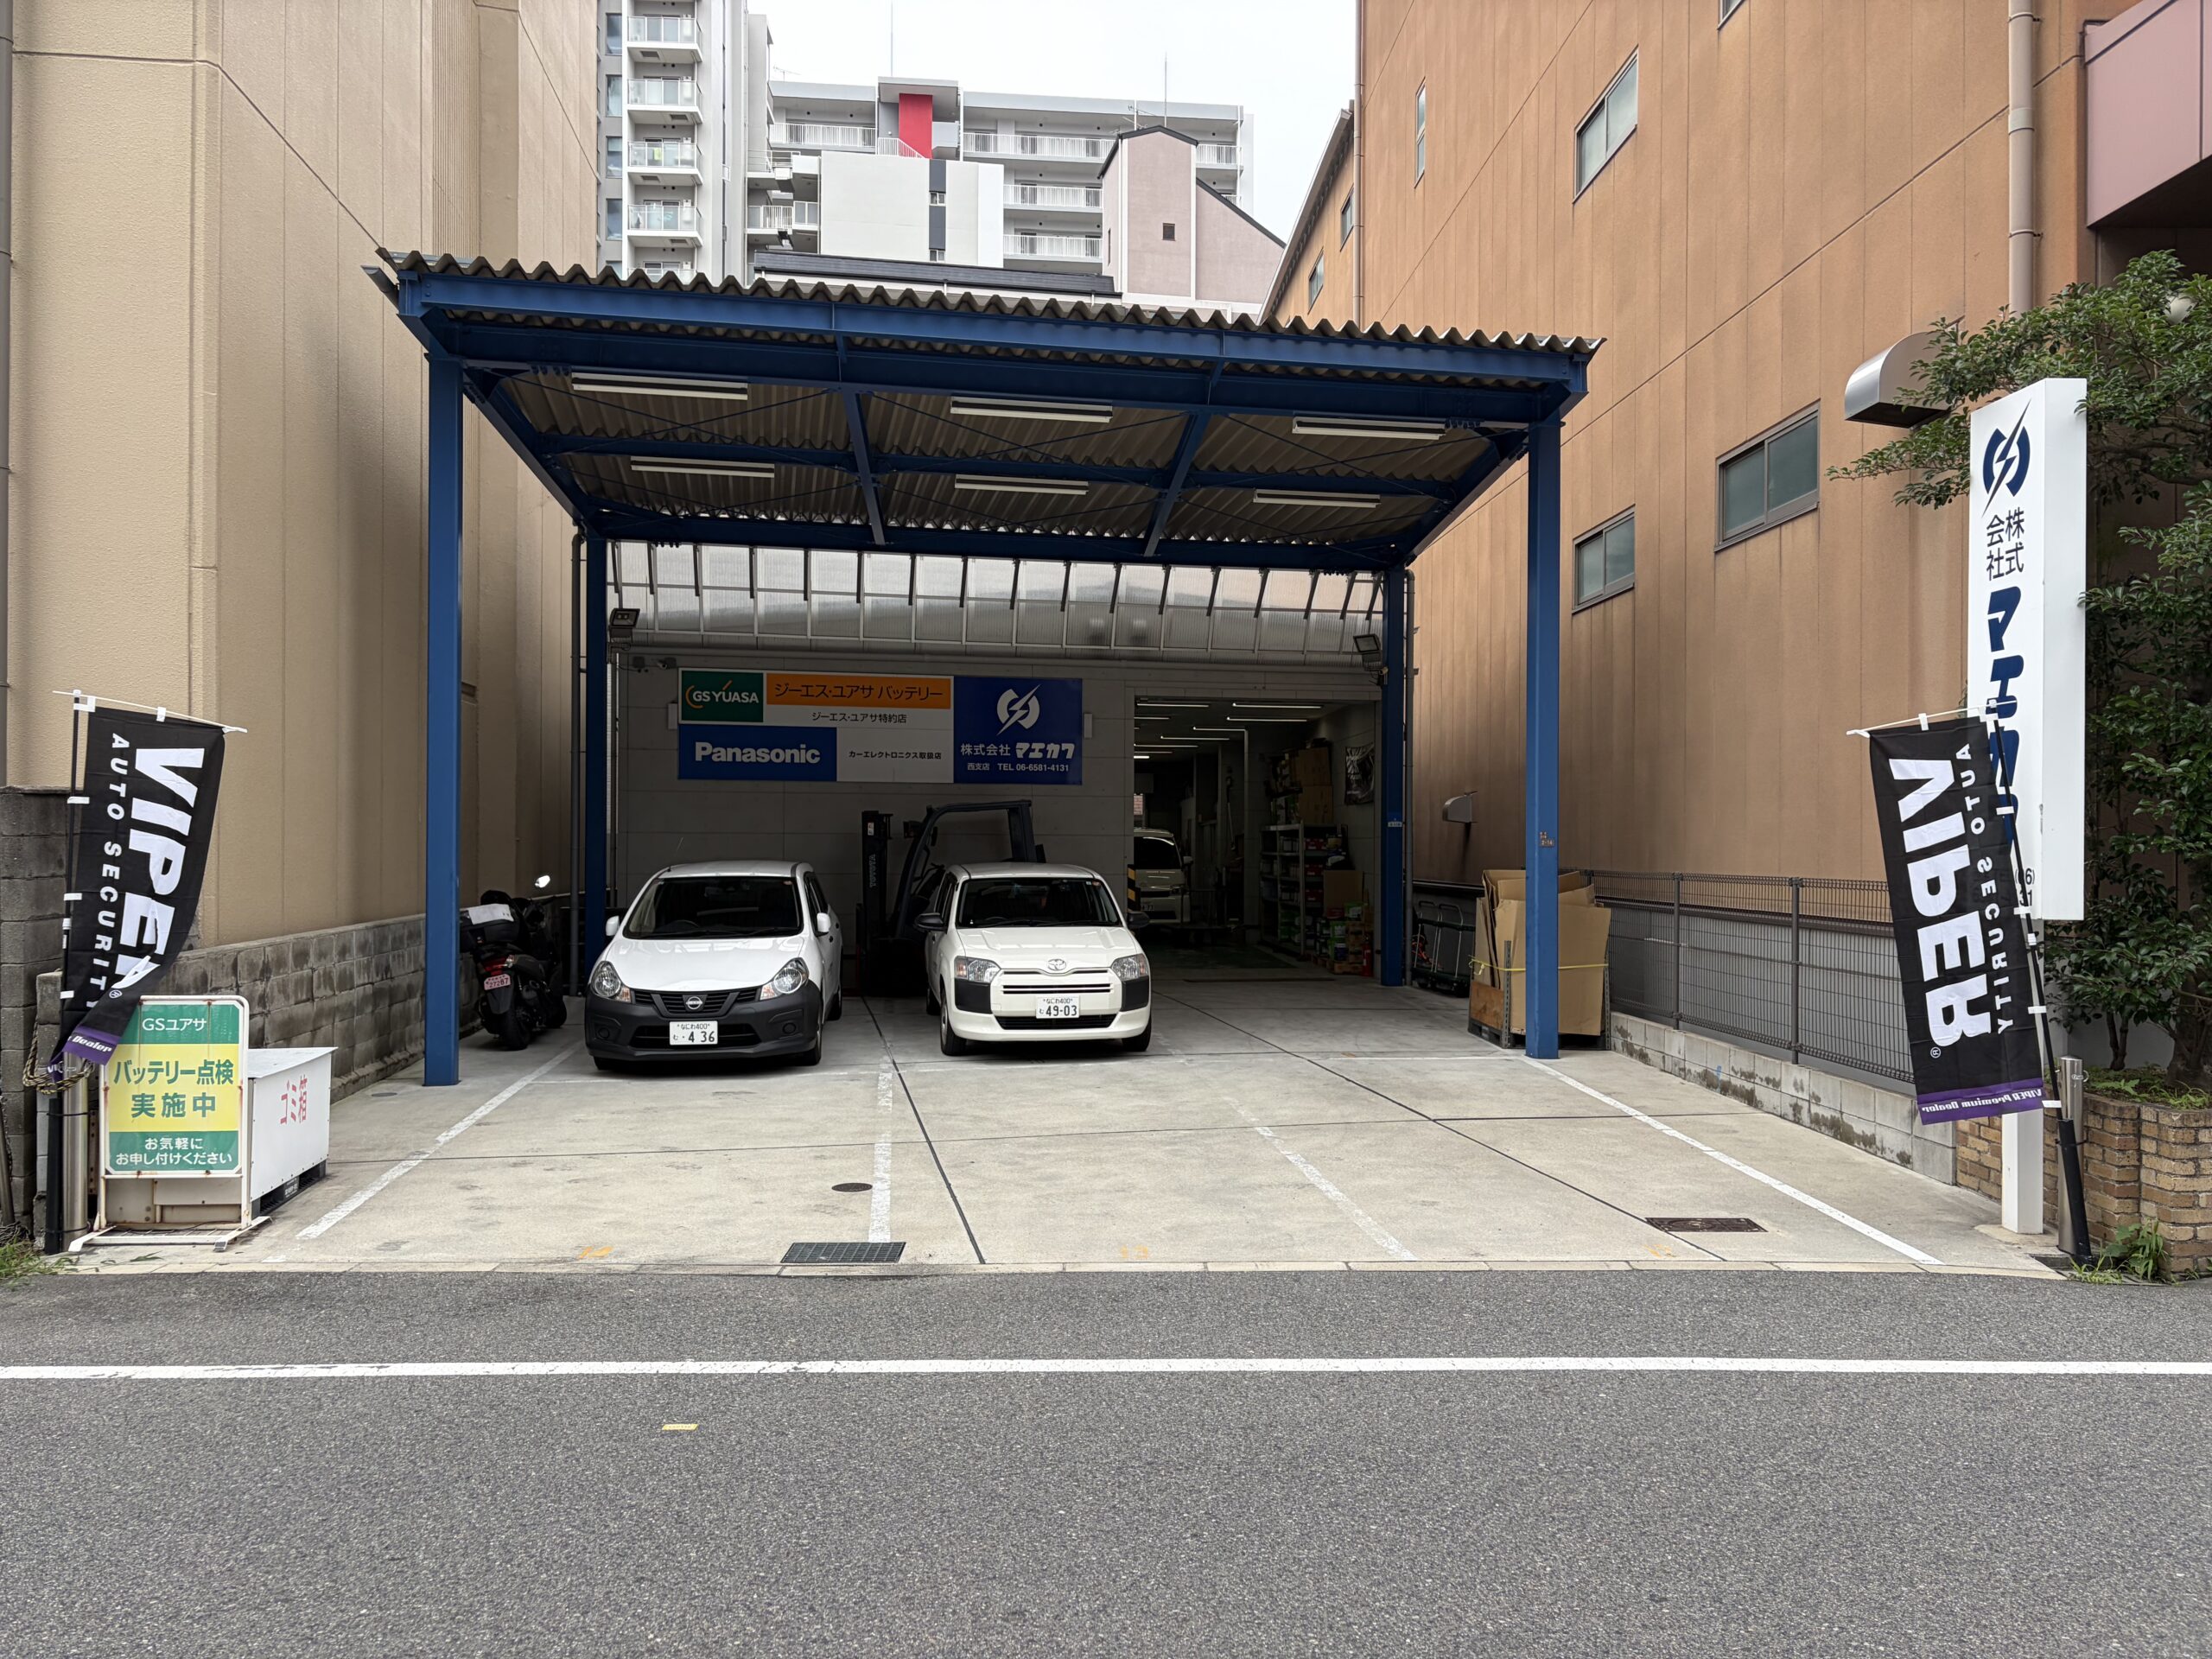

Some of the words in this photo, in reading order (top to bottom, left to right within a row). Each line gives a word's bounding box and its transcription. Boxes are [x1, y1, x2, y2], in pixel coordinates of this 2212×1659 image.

[714, 690, 760, 704] YUASA
[877, 684, 944, 701] バッテリー
[695, 741, 821, 765] Panasonic
[849, 750, 942, 760] カーエレクトロニクス取扱店
[960, 743, 1011, 757] 株式会社
[1015, 742, 1075, 759] マエカワ
[1015, 763, 1070, 772] 06-6581-4131
[106, 733, 130, 820] AUTO
[1046, 1005, 1077, 1016] 49-03
[142, 1018, 207, 1032] GSユアサ
[72, 1035, 112, 1052] Dealer
[113, 1059, 234, 1085] バッテリー点検
[130, 1092, 216, 1118] 実施中
[280, 1074, 308, 1125] ゴミ箱
[144, 1137, 203, 1150] お気軽に
[116, 1152, 232, 1166] お申し付けください
